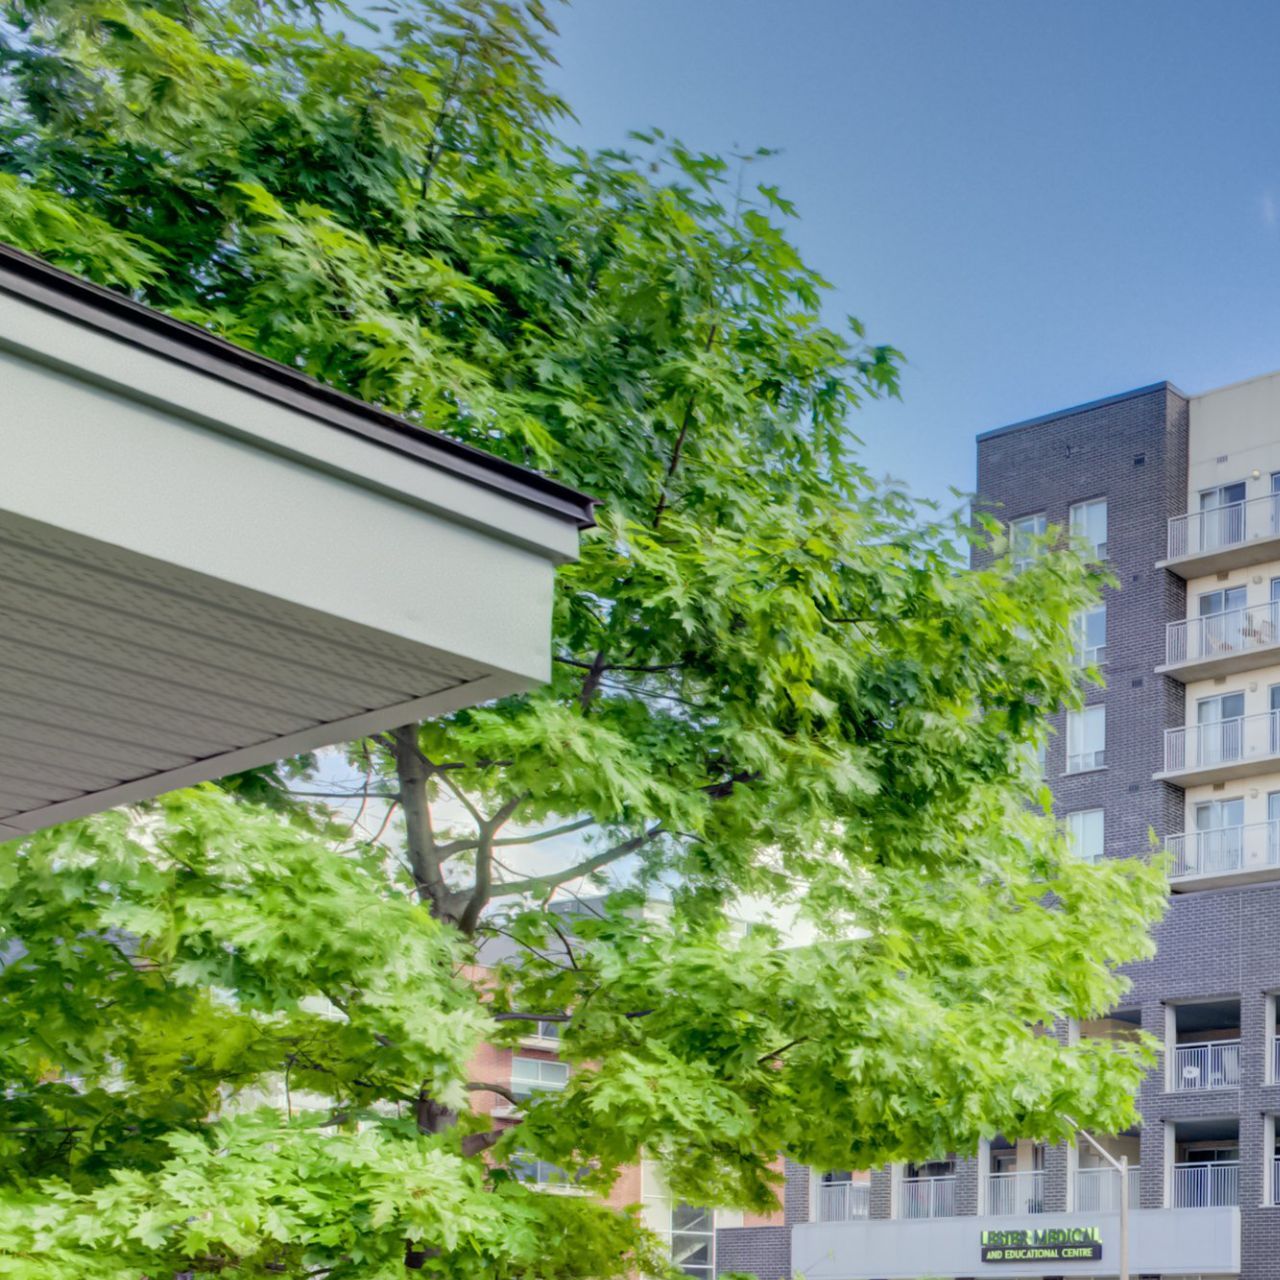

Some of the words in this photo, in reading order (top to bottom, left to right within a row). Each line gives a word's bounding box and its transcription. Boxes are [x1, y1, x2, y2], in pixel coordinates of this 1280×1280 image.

[1033, 1226, 1102, 1246] MEDICAL
[986, 1249, 1002, 1259] AND
[1005, 1248, 1059, 1259] EDUCATIONAL
[1062, 1247, 1093, 1258] CENTRE
